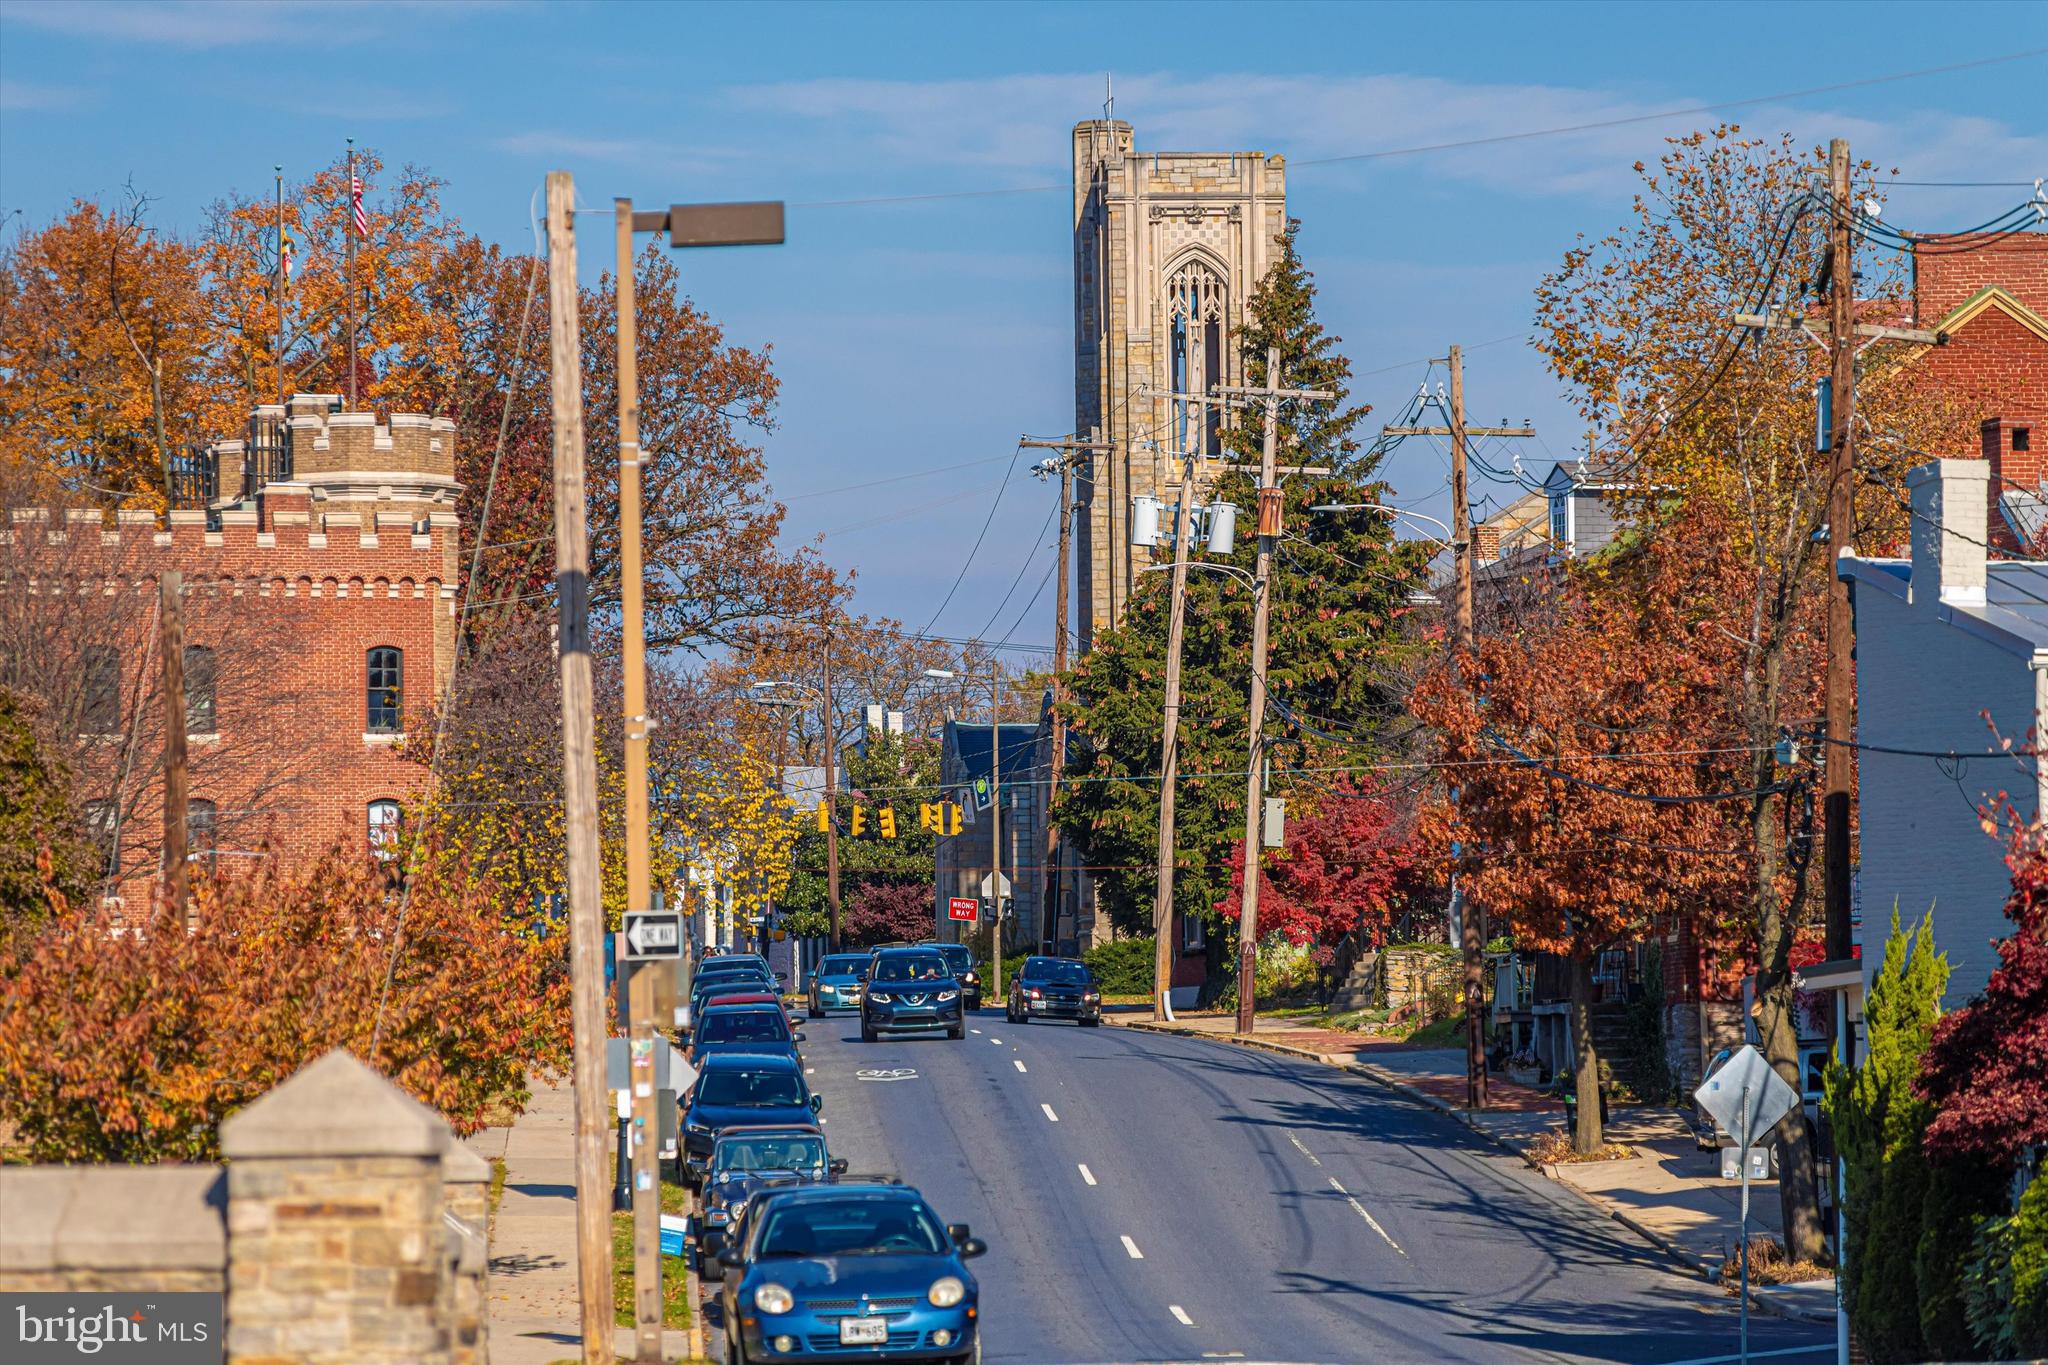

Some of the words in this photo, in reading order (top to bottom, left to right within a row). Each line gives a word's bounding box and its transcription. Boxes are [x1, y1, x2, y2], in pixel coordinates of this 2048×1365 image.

[952, 901, 974, 909] WRONG
[956, 909, 970, 917] WAY
[642, 927, 655, 942] ONE
[659, 927, 673, 941] WAY
